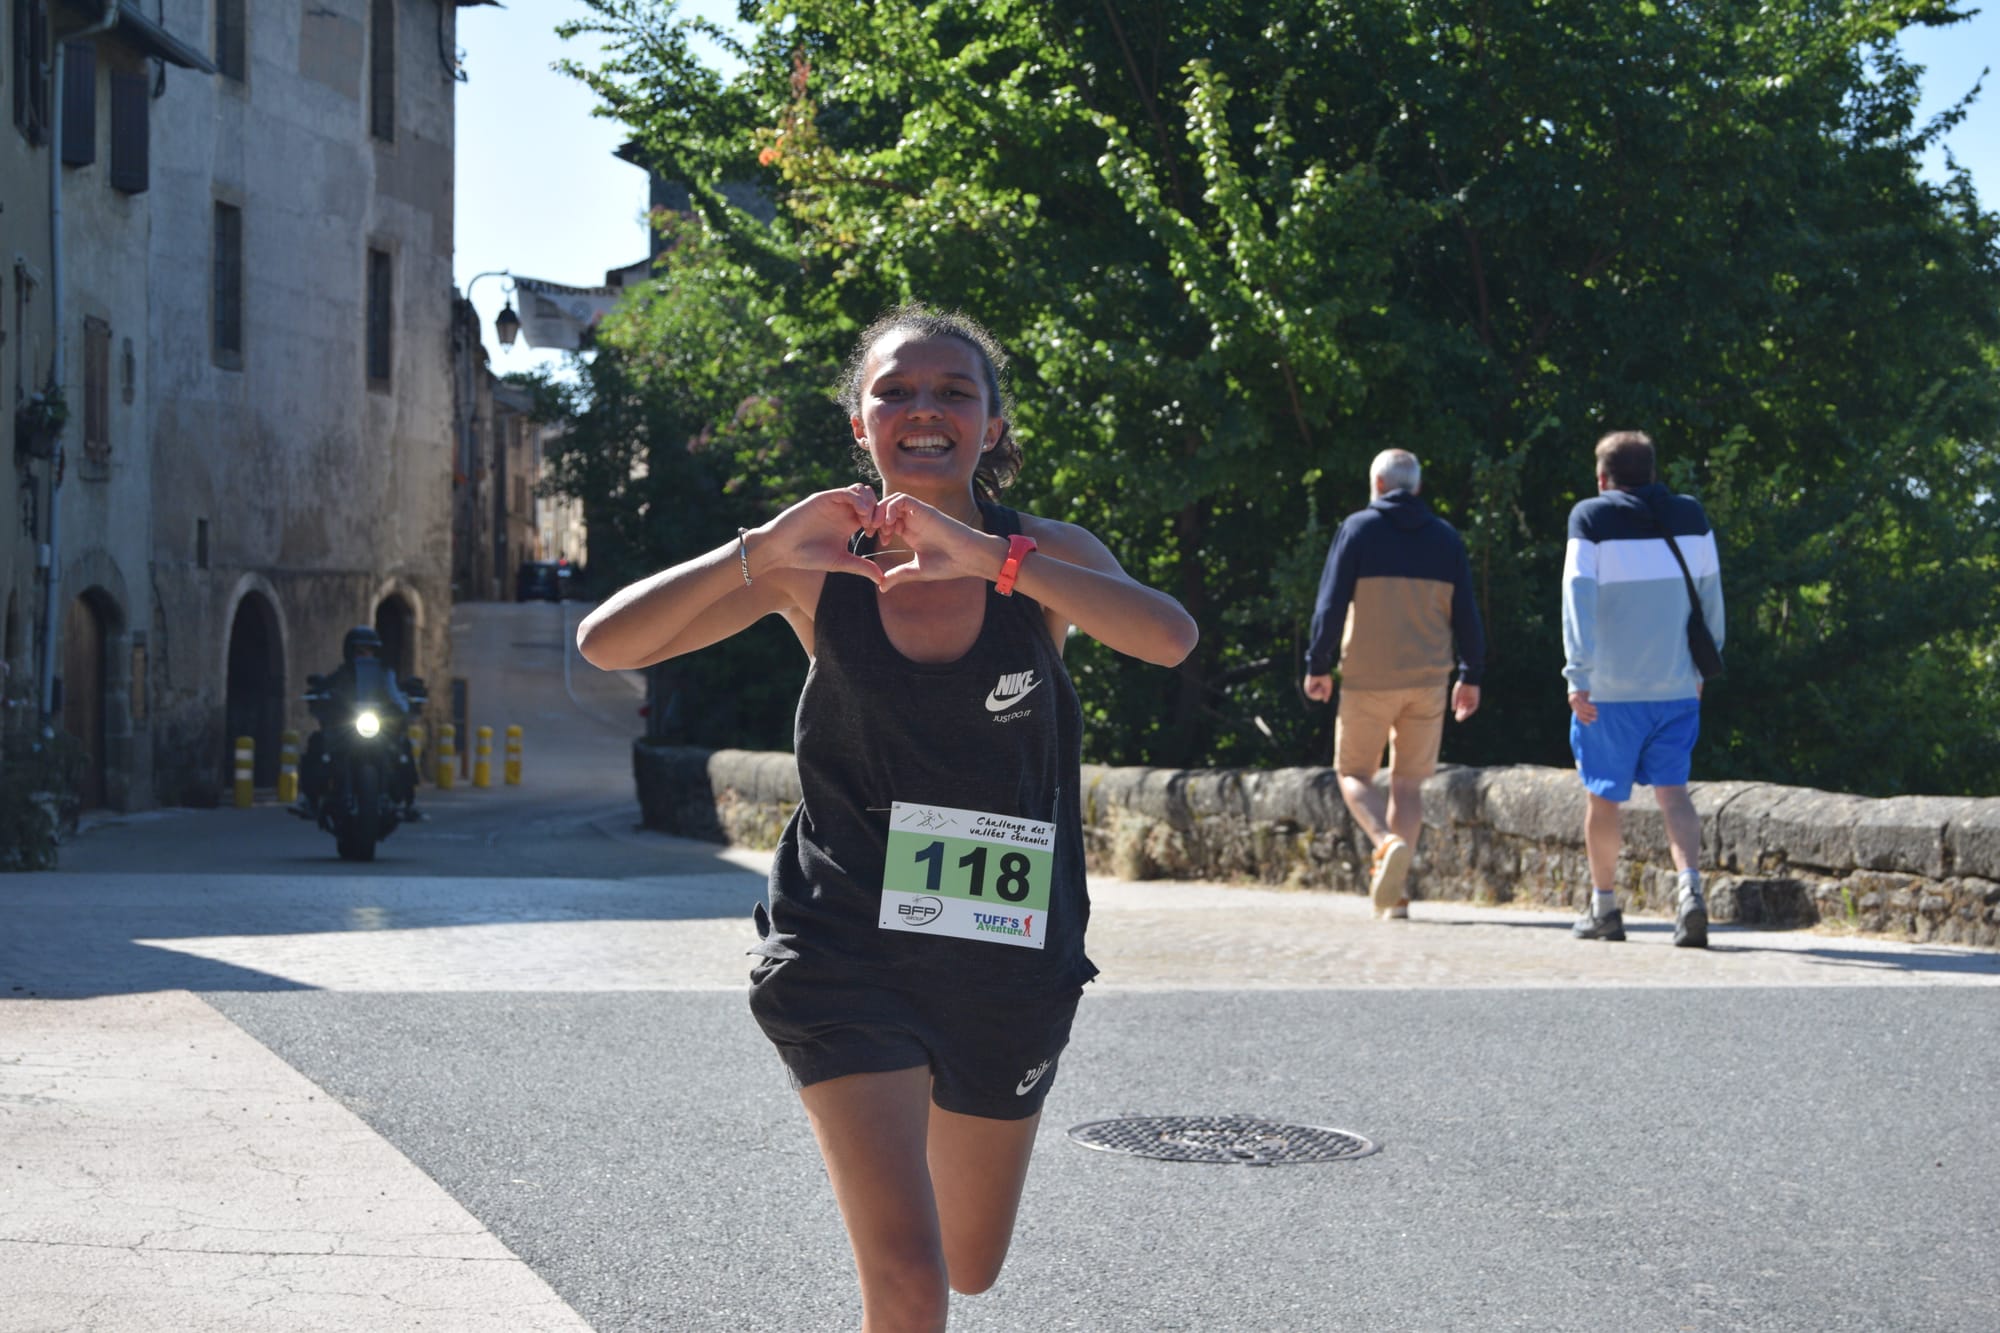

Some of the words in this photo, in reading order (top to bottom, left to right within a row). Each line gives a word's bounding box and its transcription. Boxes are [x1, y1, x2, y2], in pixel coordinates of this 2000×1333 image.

[995, 669, 1034, 696] NIKE
[993, 714, 1011, 723] JUST
[1011, 711, 1023, 719] DO
[1024, 709, 1031, 717] IT
[976, 816, 1026, 834] Challenge
[1031, 825, 1046, 835] des
[969, 827, 1006, 839] vallées
[1010, 832, 1049, 846] cévenoles
[914, 841, 1031, 902] 118
[898, 904, 936, 917] BFP
[973, 912, 1019, 929] TUFF'S
[976, 921, 1023, 936] Aventure
